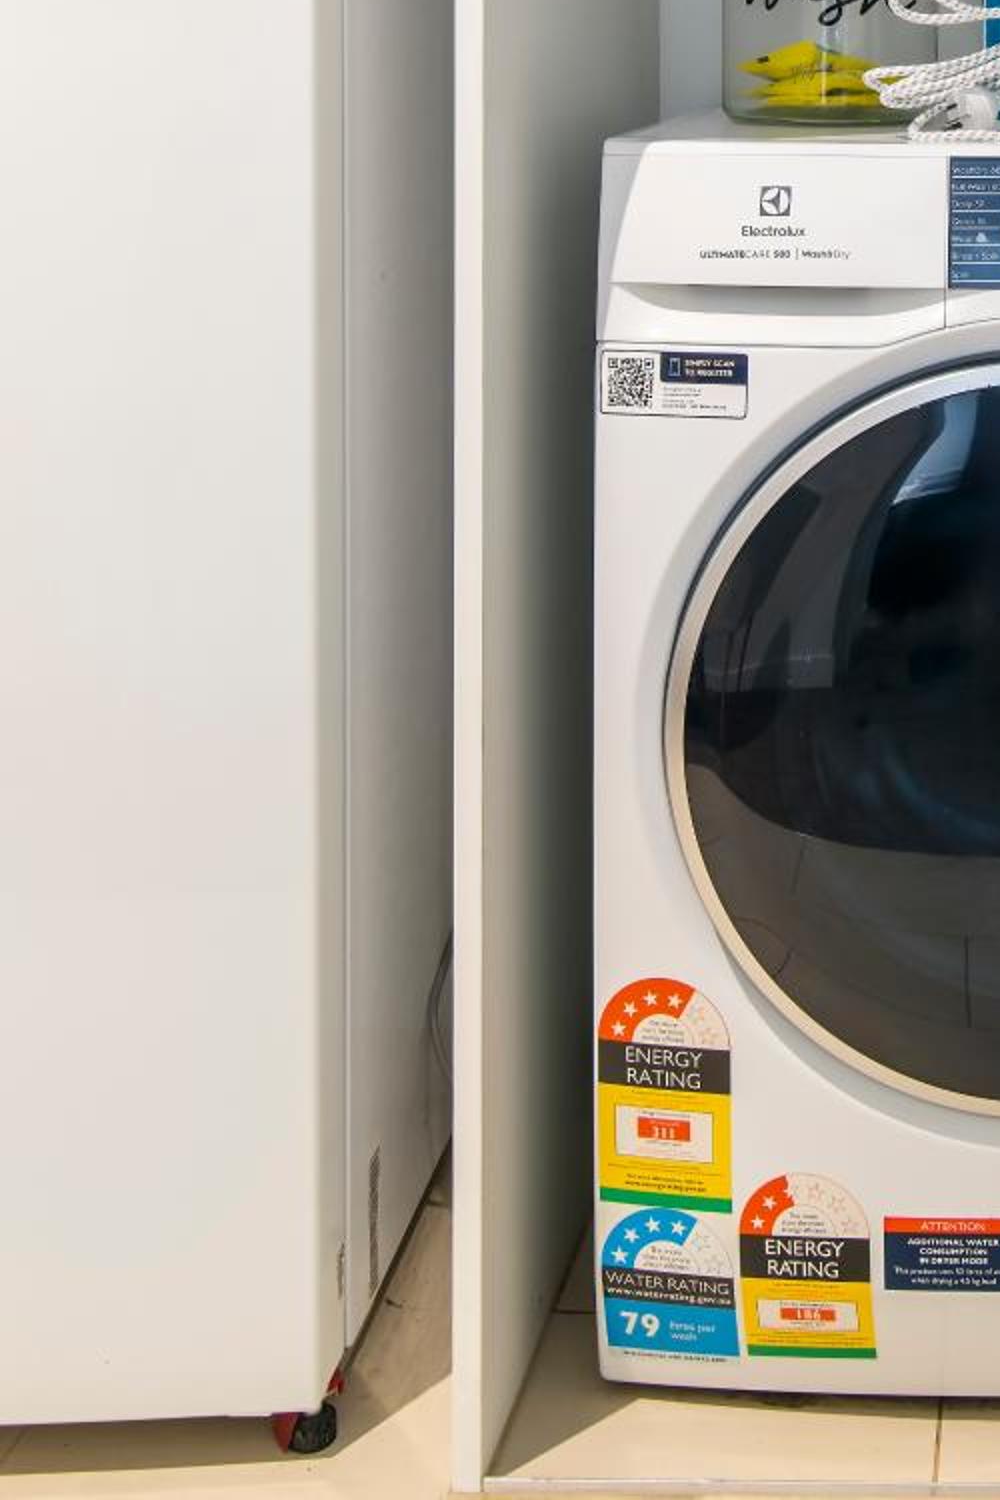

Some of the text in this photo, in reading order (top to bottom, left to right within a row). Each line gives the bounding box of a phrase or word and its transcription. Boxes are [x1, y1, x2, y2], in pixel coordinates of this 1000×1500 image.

[741, 225, 806, 237] Electrolux
[625, 1045, 703, 1068] ENERGY
[626, 1067, 701, 1089] RATING
[920, 1220, 986, 1232] ATTENTION
[765, 1239, 845, 1258] ENERGY
[907, 1237, 1000, 1247] ADDITIONAL WATER
[919, 1247, 988, 1256] CONSUMPTION
[767, 1259, 840, 1278] RATING
[961, 1257, 989, 1265] MODE
[605, 1270, 734, 1296] WATER RATING
[619, 1310, 661, 1338] 79
